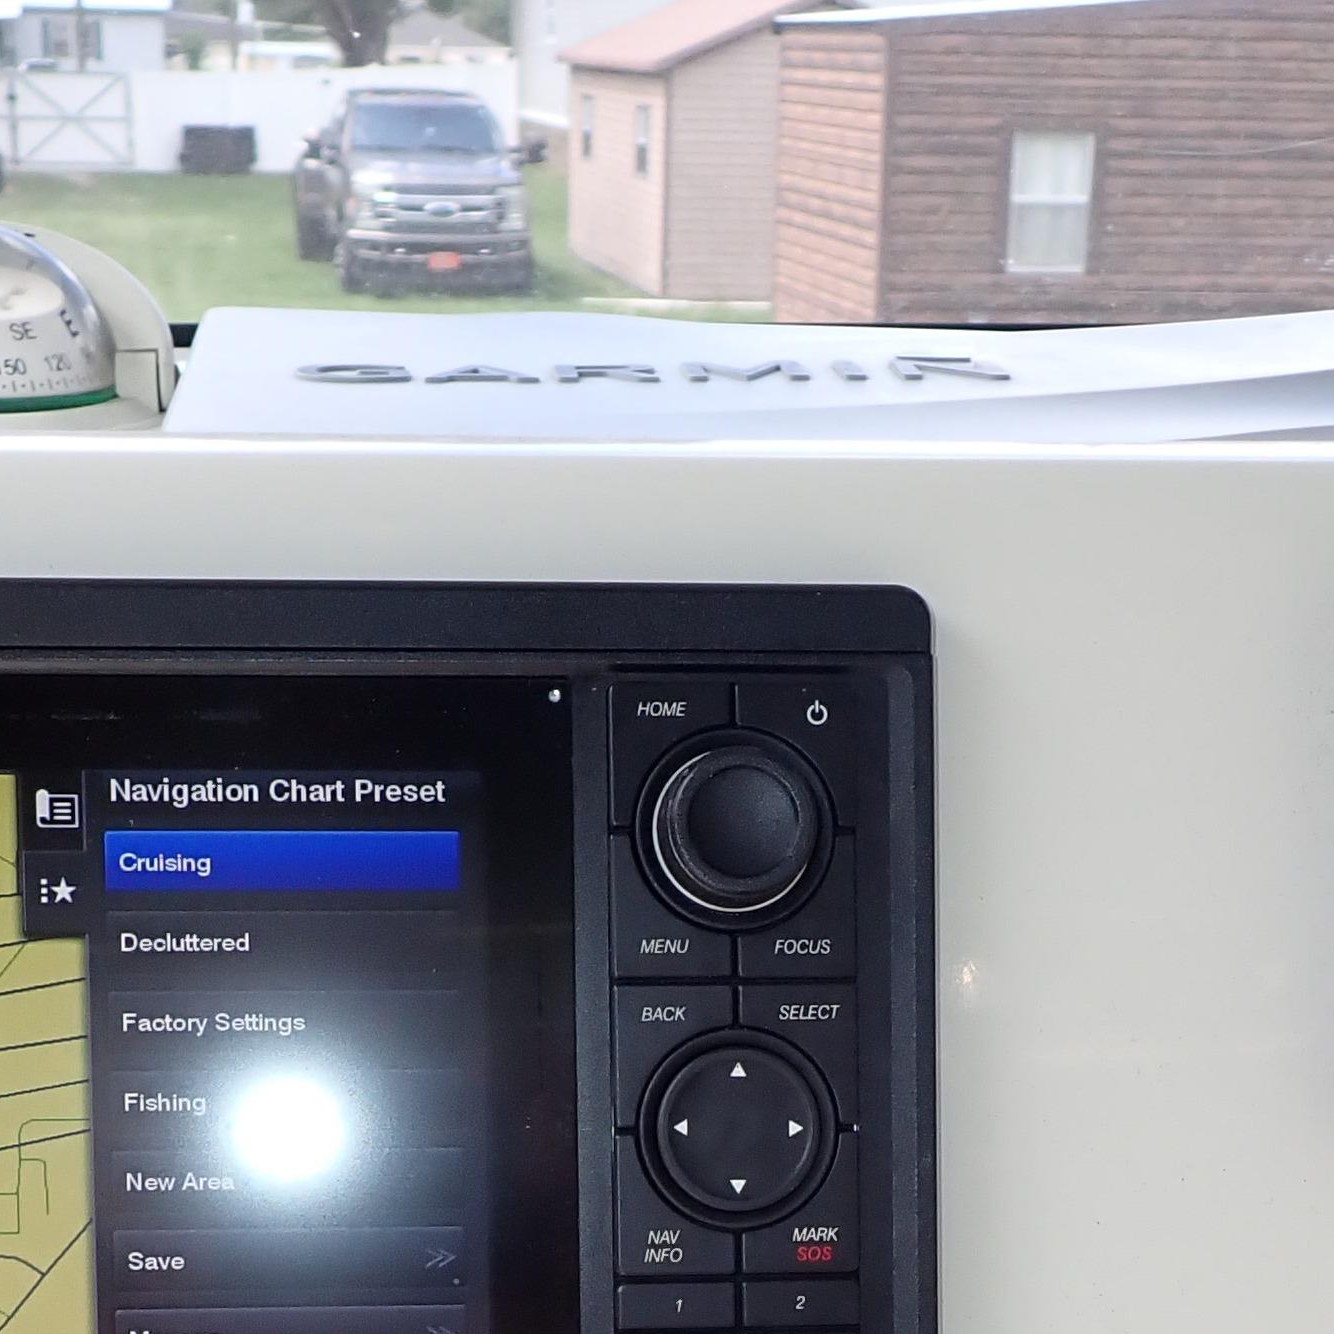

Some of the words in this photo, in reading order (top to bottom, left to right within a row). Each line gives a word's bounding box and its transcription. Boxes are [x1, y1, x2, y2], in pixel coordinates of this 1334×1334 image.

[9, 321, 37, 341] SE
[293, 354, 1012, 384] GARMIN
[636, 701, 687, 717] HOME
[110, 778, 259, 809] Navigation
[269, 778, 345, 803] Chart
[355, 778, 446, 803] Preset
[119, 852, 212, 876] Cruising
[120, 932, 250, 954] Decluttered
[640, 938, 690, 954] MENU
[774, 938, 832, 955] FOCUS
[641, 1006, 686, 1022] BACK
[778, 1004, 840, 1020] SELECT
[122, 1013, 207, 1036] Factory
[215, 1012, 306, 1034] Settings
[124, 1092, 207, 1116] Fishing
[126, 1172, 176, 1192] New
[182, 1172, 235, 1192] Area
[647, 1230, 681, 1246] NAV
[793, 1227, 839, 1243] MARK
[127, 1251, 186, 1272] Save
[644, 1247, 683, 1263] INFO
[796, 1246, 833, 1261] SOS
[675, 1299, 683, 1313] 1
[796, 1295, 806, 1310] 2
